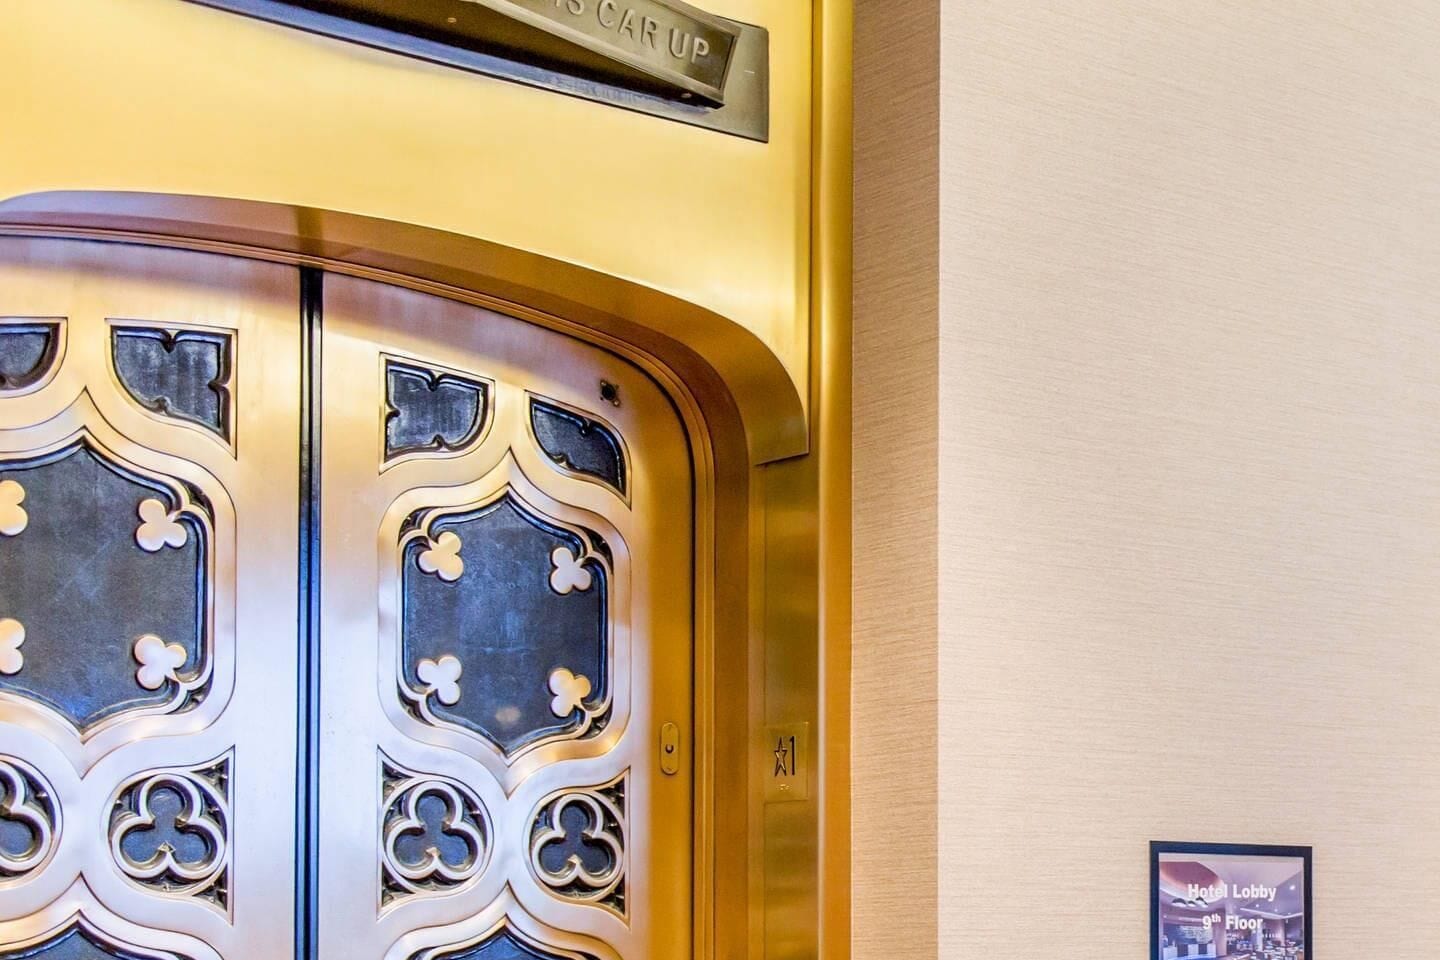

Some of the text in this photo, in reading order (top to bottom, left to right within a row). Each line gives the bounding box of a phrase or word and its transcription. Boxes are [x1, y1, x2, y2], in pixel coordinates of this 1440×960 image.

[597, 0, 710, 63] CAR UP
[1187, 883, 1277, 902] Hotel Lobby
[1202, 913, 1263, 930] 9th Floor
